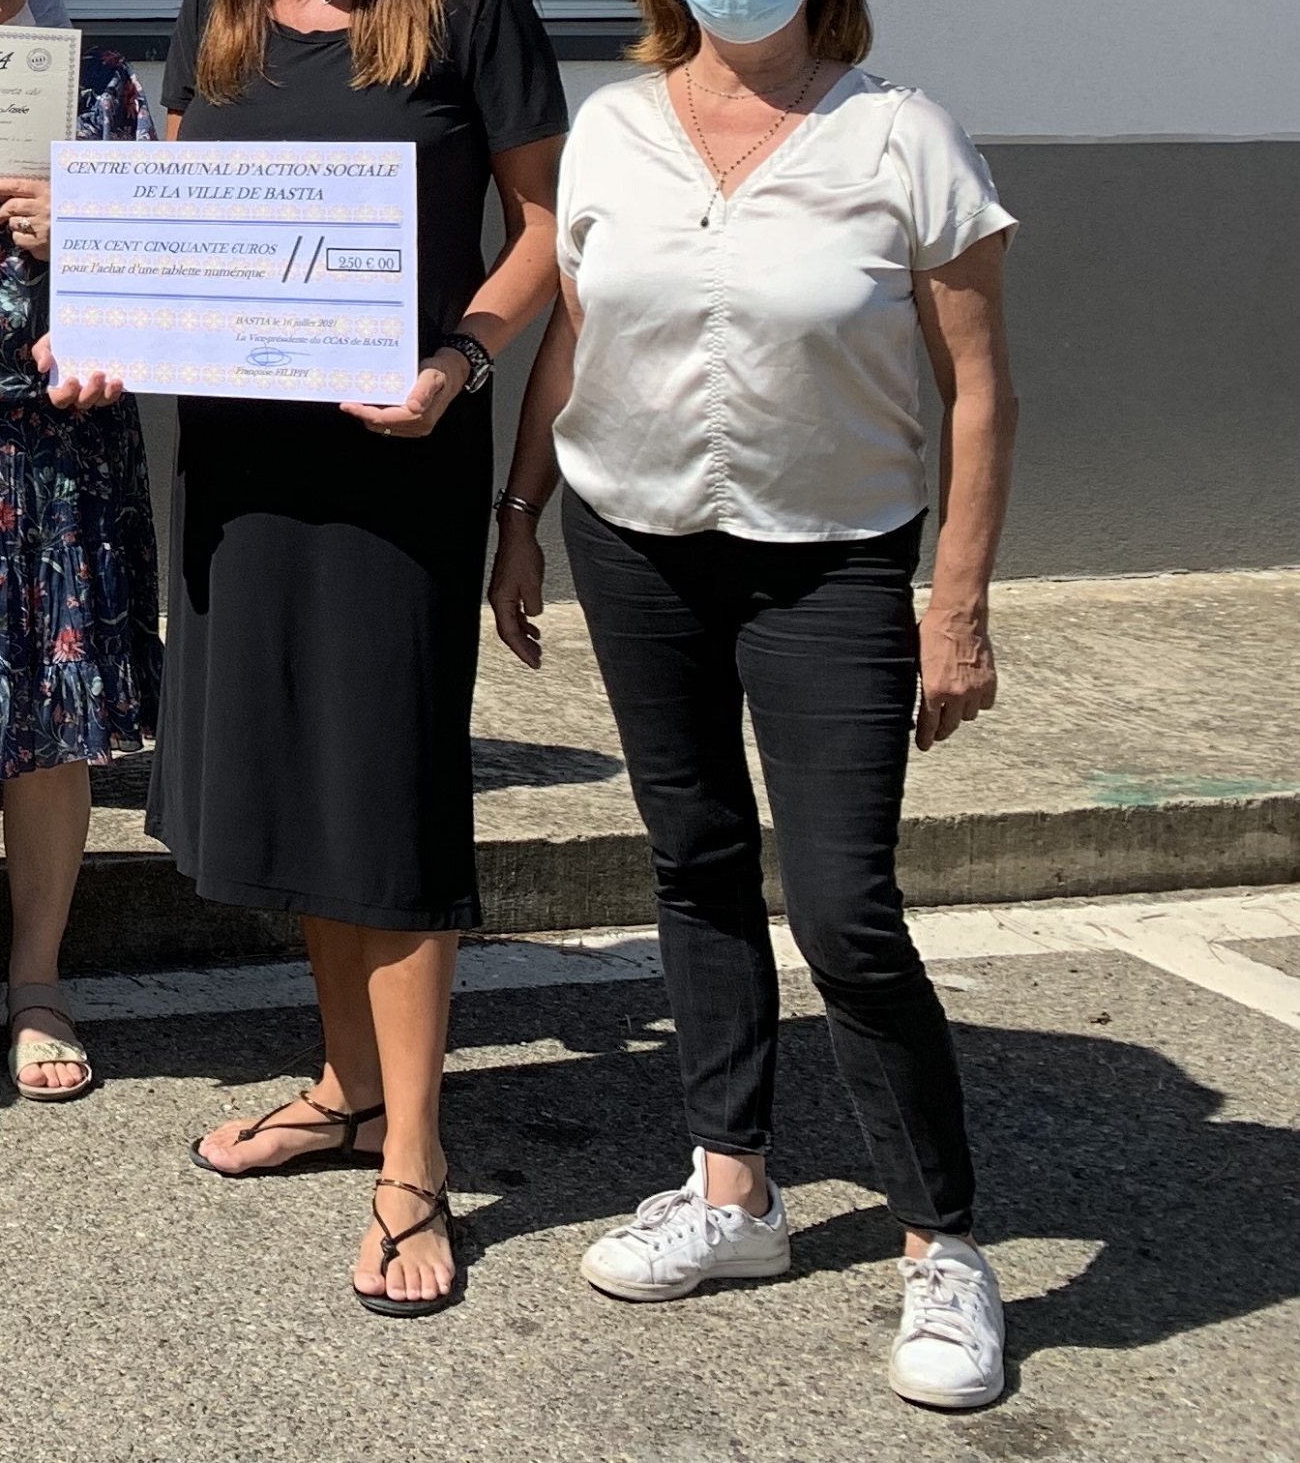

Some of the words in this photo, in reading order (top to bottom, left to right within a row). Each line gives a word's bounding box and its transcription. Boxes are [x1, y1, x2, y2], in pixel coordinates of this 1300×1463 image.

[67, 161, 132, 175] CENTRE
[133, 162, 233, 176] COMMUNAL
[237, 163, 323, 177] D'ACTION
[322, 163, 400, 178] SOCIALE
[132, 185, 158, 199] DE
[159, 186, 181, 199] LA
[187, 186, 235, 200] VILLE
[236, 187, 262, 200] DE
[263, 187, 325, 201] BASTIA
[62, 239, 102, 251] DEUX
[104, 240, 144, 252] CENT
[144, 241, 229, 254] CINQUANTE
[338, 256, 363, 269] 250
[366, 257, 375, 269] €
[378, 257, 395, 270] 00
[61, 263, 88, 275] pour
[91, 263, 127, 275] l'achat
[128, 264, 159, 275] d'une
[161, 265, 202, 276] tablette
[204, 266, 266, 280] numérique
[235, 317, 271, 326] BASTIA
[272, 317, 281, 326] le
[282, 318, 293, 327] 16
[293, 318, 319, 329] juillet
[235, 333, 247, 342] La
[310, 336, 322, 344] du
[322, 336, 350, 346] CCAS
[350, 337, 362, 346] de
[362, 338, 400, 348] BASTIA
[235, 367, 273, 377] Françoise
[275, 368, 311, 378] FILIPPI
